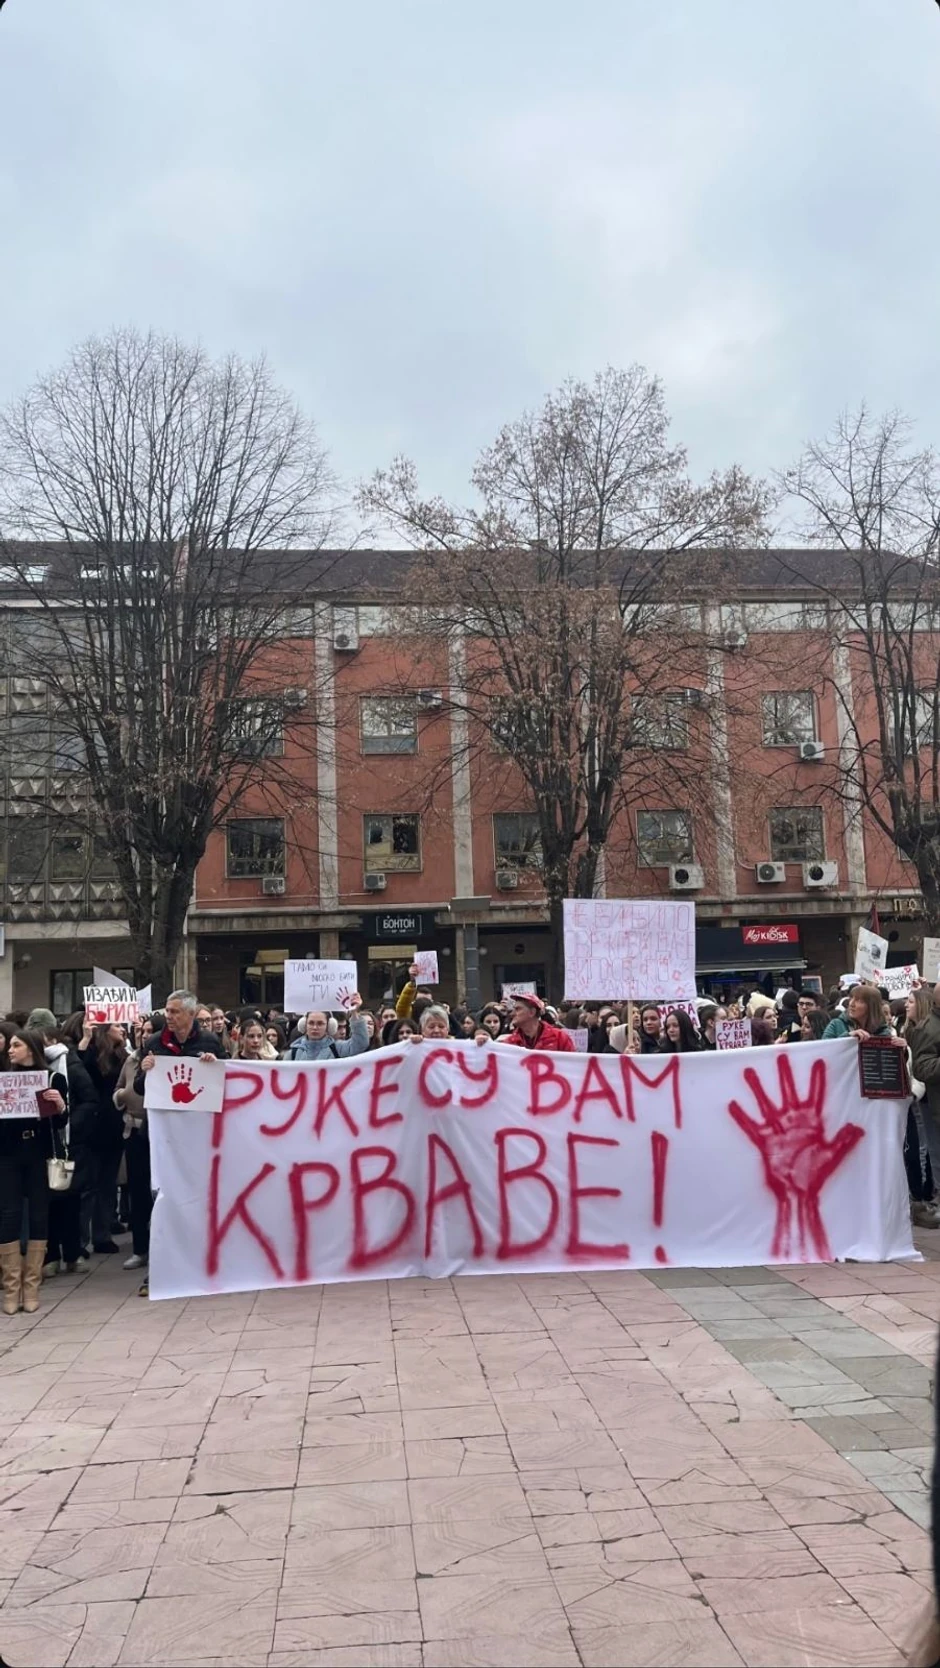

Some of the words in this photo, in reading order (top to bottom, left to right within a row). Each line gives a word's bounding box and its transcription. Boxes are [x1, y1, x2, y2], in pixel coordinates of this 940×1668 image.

[382, 918, 415, 929] БОНТОН
[745, 928, 760, 943] Moj
[760, 928, 788, 941] KIOSK
[290, 961, 315, 972] ТАМО
[86, 987, 127, 1002] ИЗАЂИ
[128, 988, 137, 1002] И
[309, 984, 329, 1002] ТИ
[722, 1021, 744, 1031] РУКЕ
[717, 1032, 731, 1042] СУ
[734, 1030, 750, 1040] ВАМ
[213, 1054, 403, 1147] РУКЕ
[418, 1048, 499, 1108] СУ
[521, 1054, 682, 1130] ВАМ
